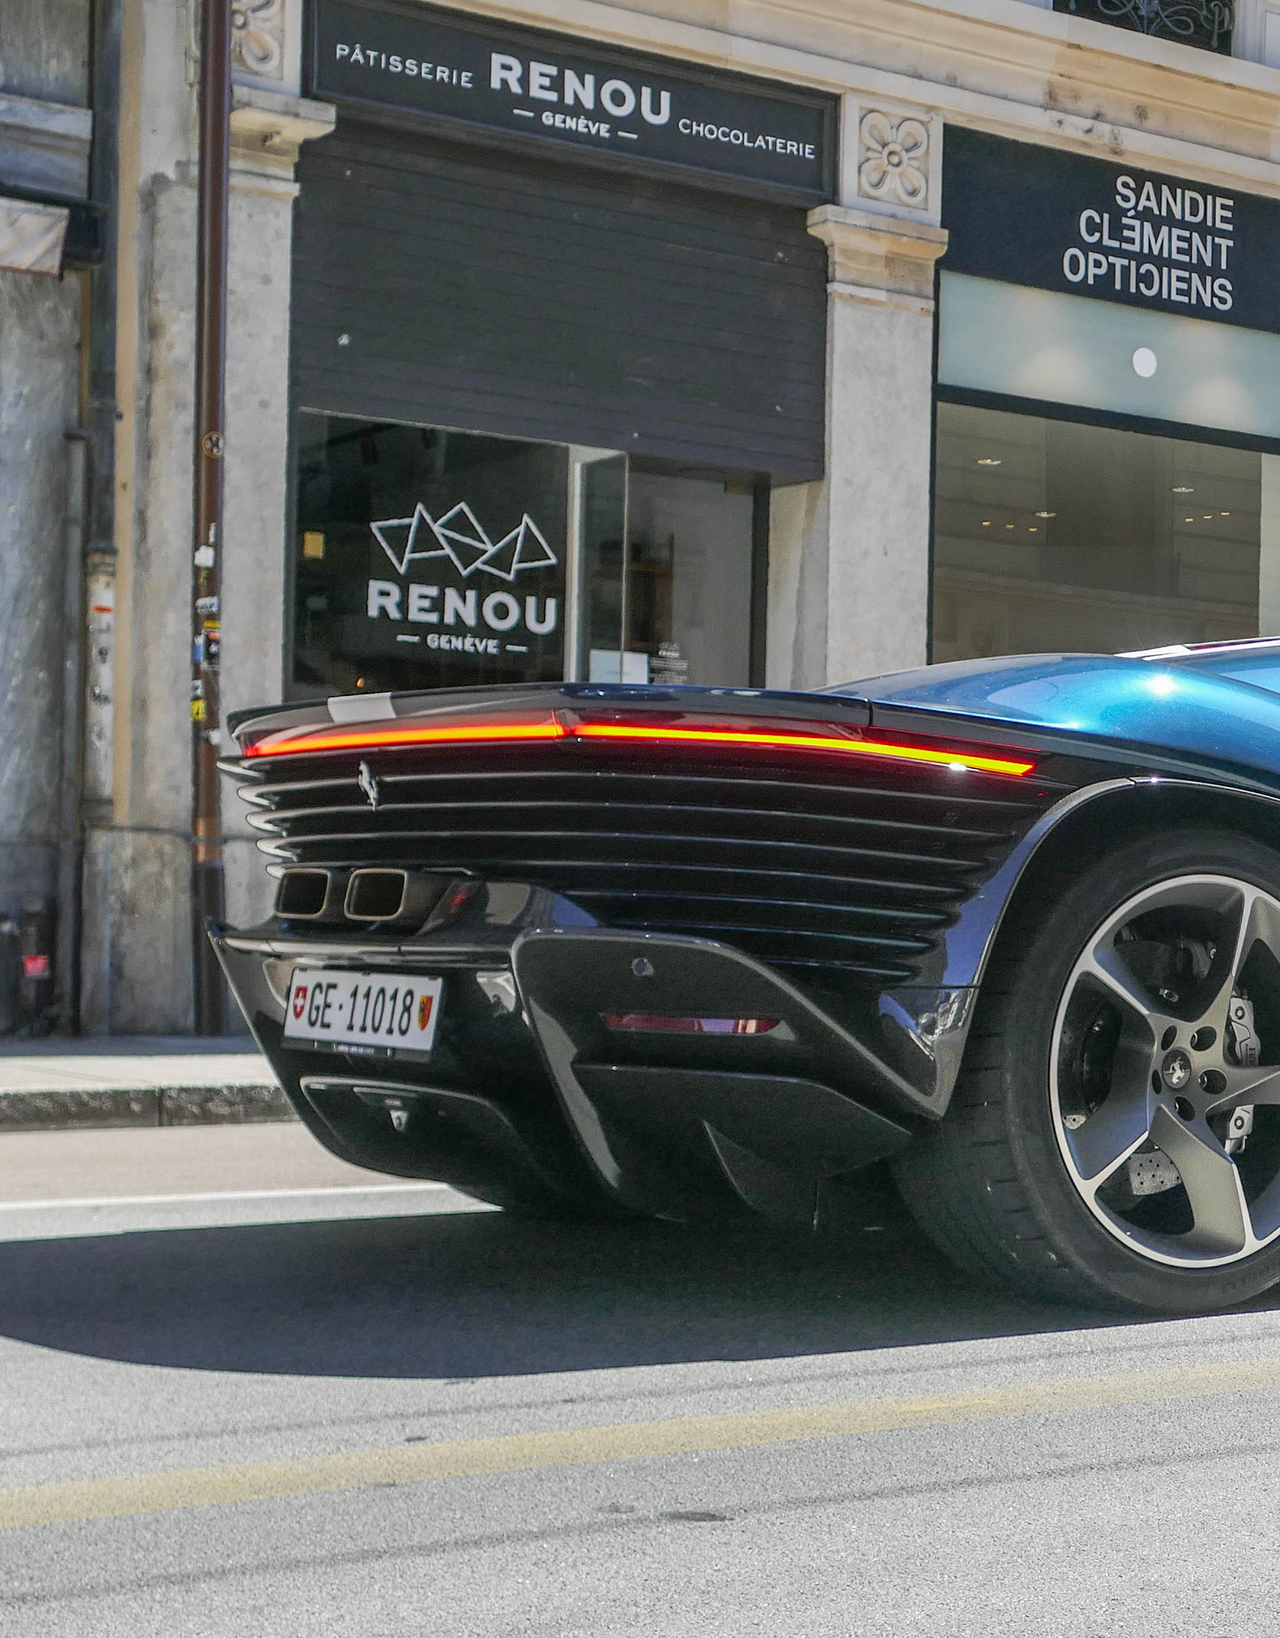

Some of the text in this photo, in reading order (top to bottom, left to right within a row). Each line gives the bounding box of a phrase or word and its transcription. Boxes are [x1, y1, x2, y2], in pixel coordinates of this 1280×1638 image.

[336, 43, 815, 160] PÂTISSERIE RENOU CHOCOLATERIE
[541, 109, 610, 138] GENÈVE
[1115, 175, 1234, 231] SANDIE
[1062, 247, 1233, 311] OPTICIENS
[366, 578, 558, 635] RENOU
[426, 633, 499, 654] GENÈVE
